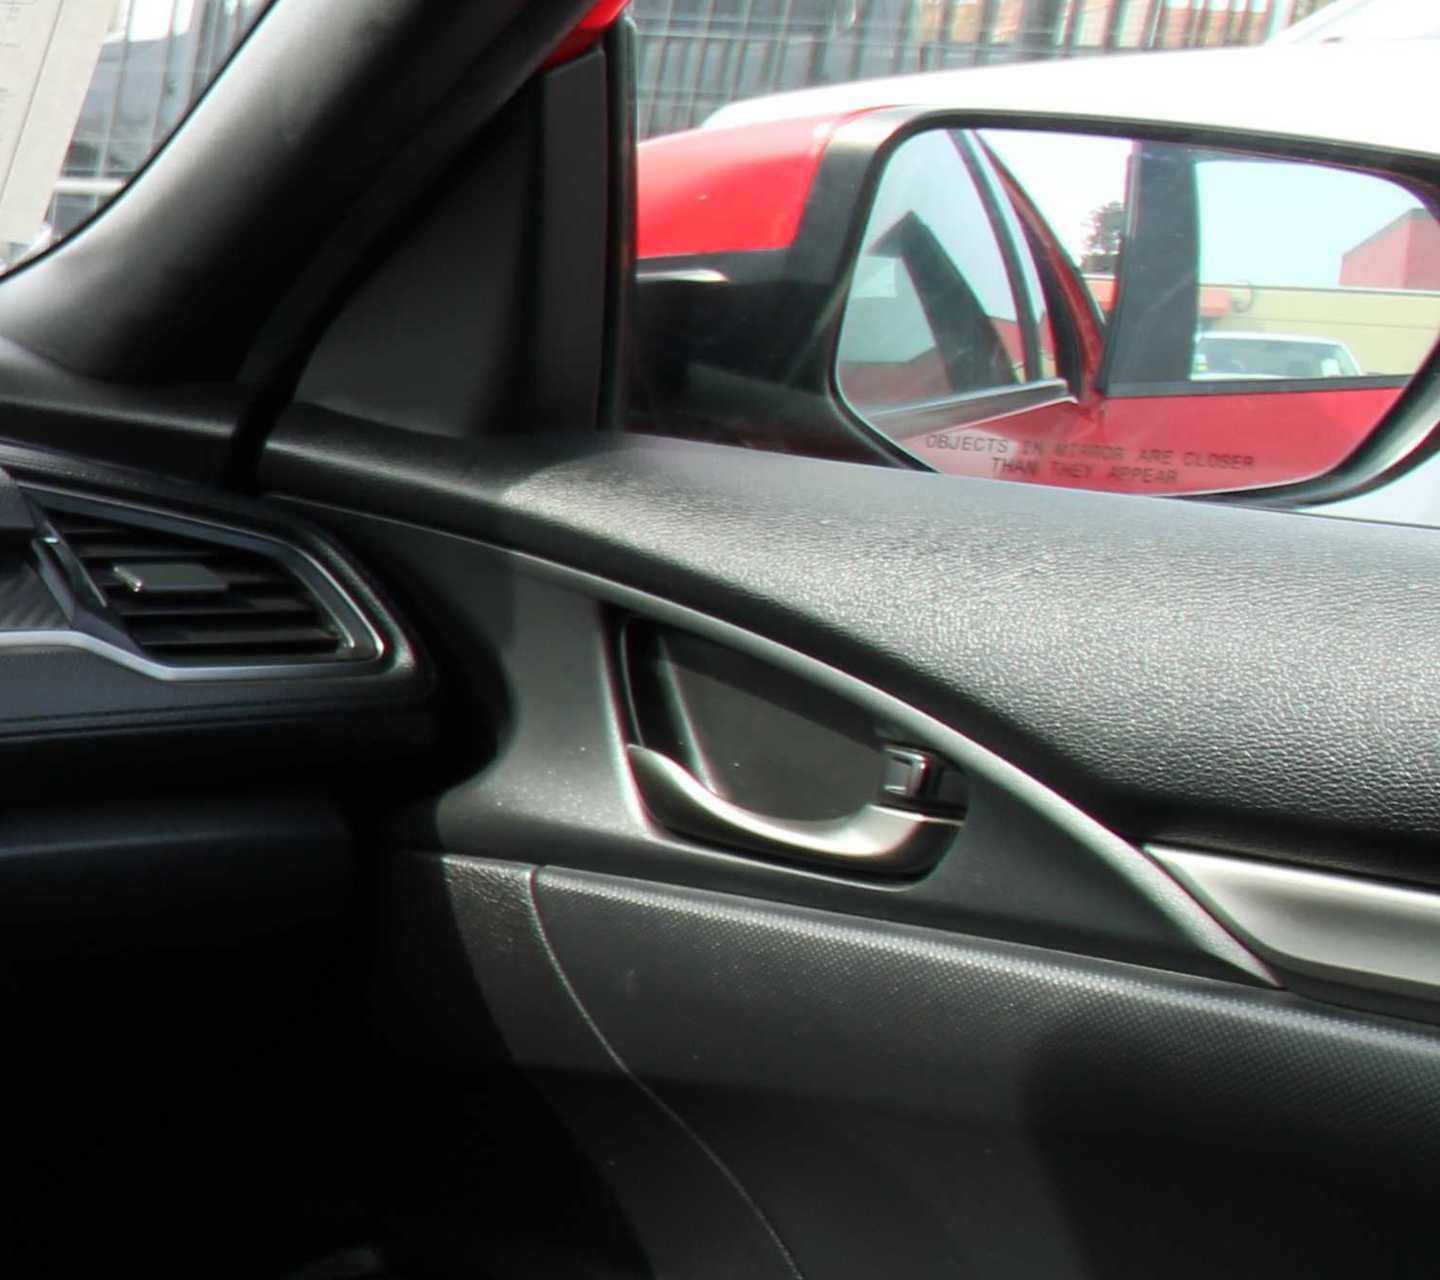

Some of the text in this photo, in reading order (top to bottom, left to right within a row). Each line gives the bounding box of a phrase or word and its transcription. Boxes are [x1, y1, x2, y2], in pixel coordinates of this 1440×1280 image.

[925, 434, 1255, 470] OBJECTS IN MIRROR ARE CLOSER
[991, 457, 1179, 483] THAN THEY APPEAR
